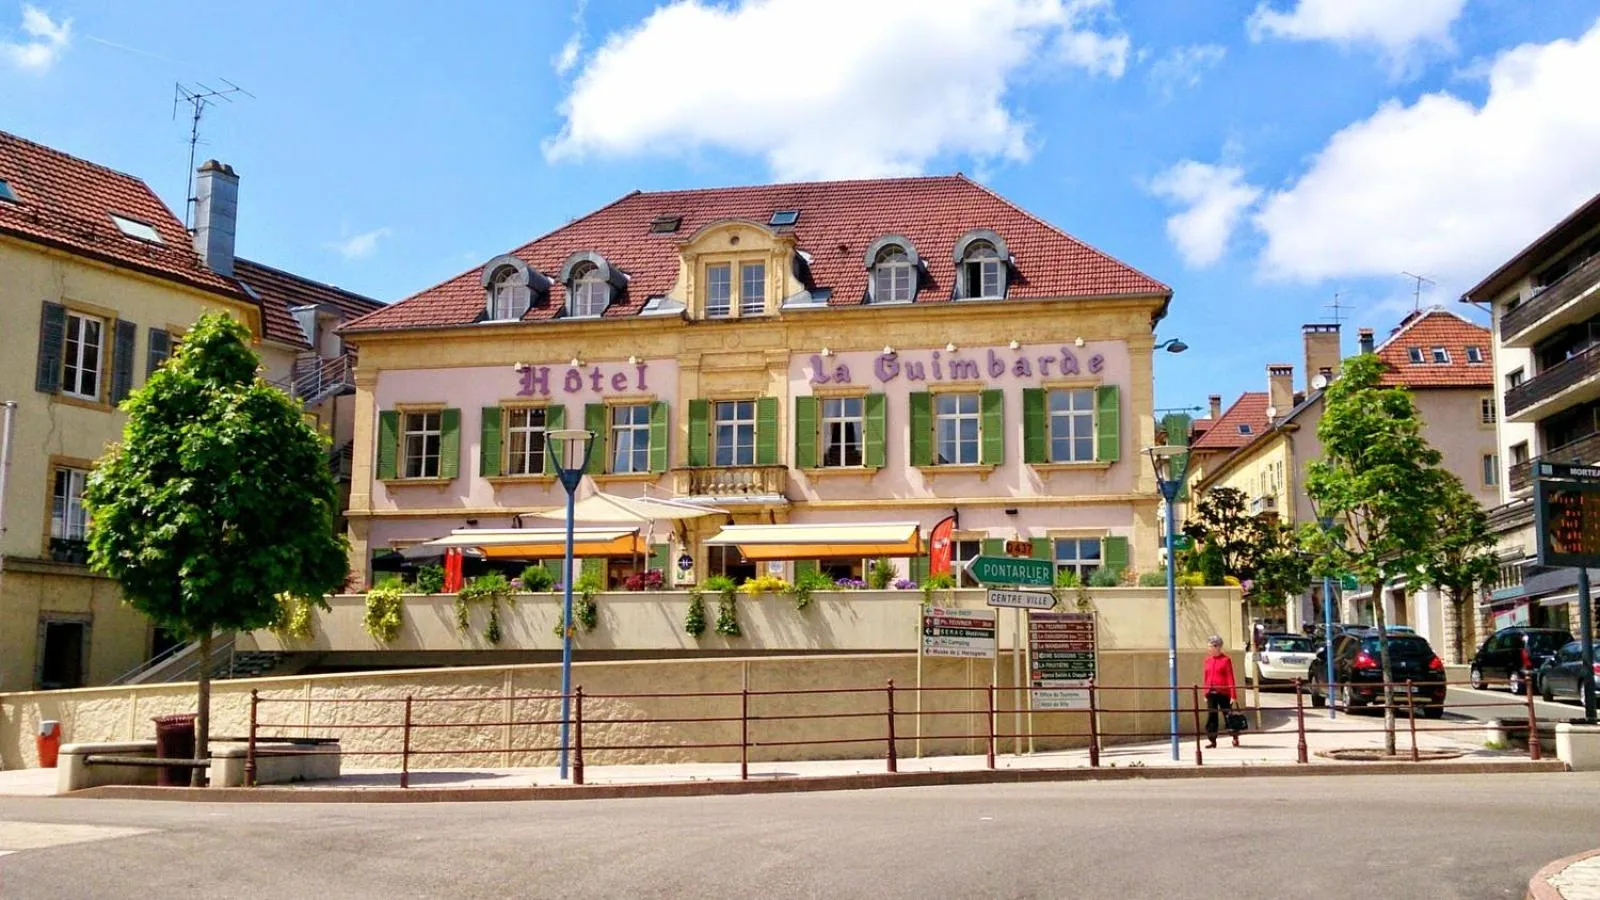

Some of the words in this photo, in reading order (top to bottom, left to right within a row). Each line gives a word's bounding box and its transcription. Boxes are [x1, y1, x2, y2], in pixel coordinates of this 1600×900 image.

[809, 354, 850, 384] La
[874, 347, 1104, 382] Guimbarde
[516, 365, 649, 396] Hôtel
[984, 563, 1050, 580] PONTARLIER
[991, 593, 1022, 603] CENTRE
[1026, 596, 1048, 605] VILLE
